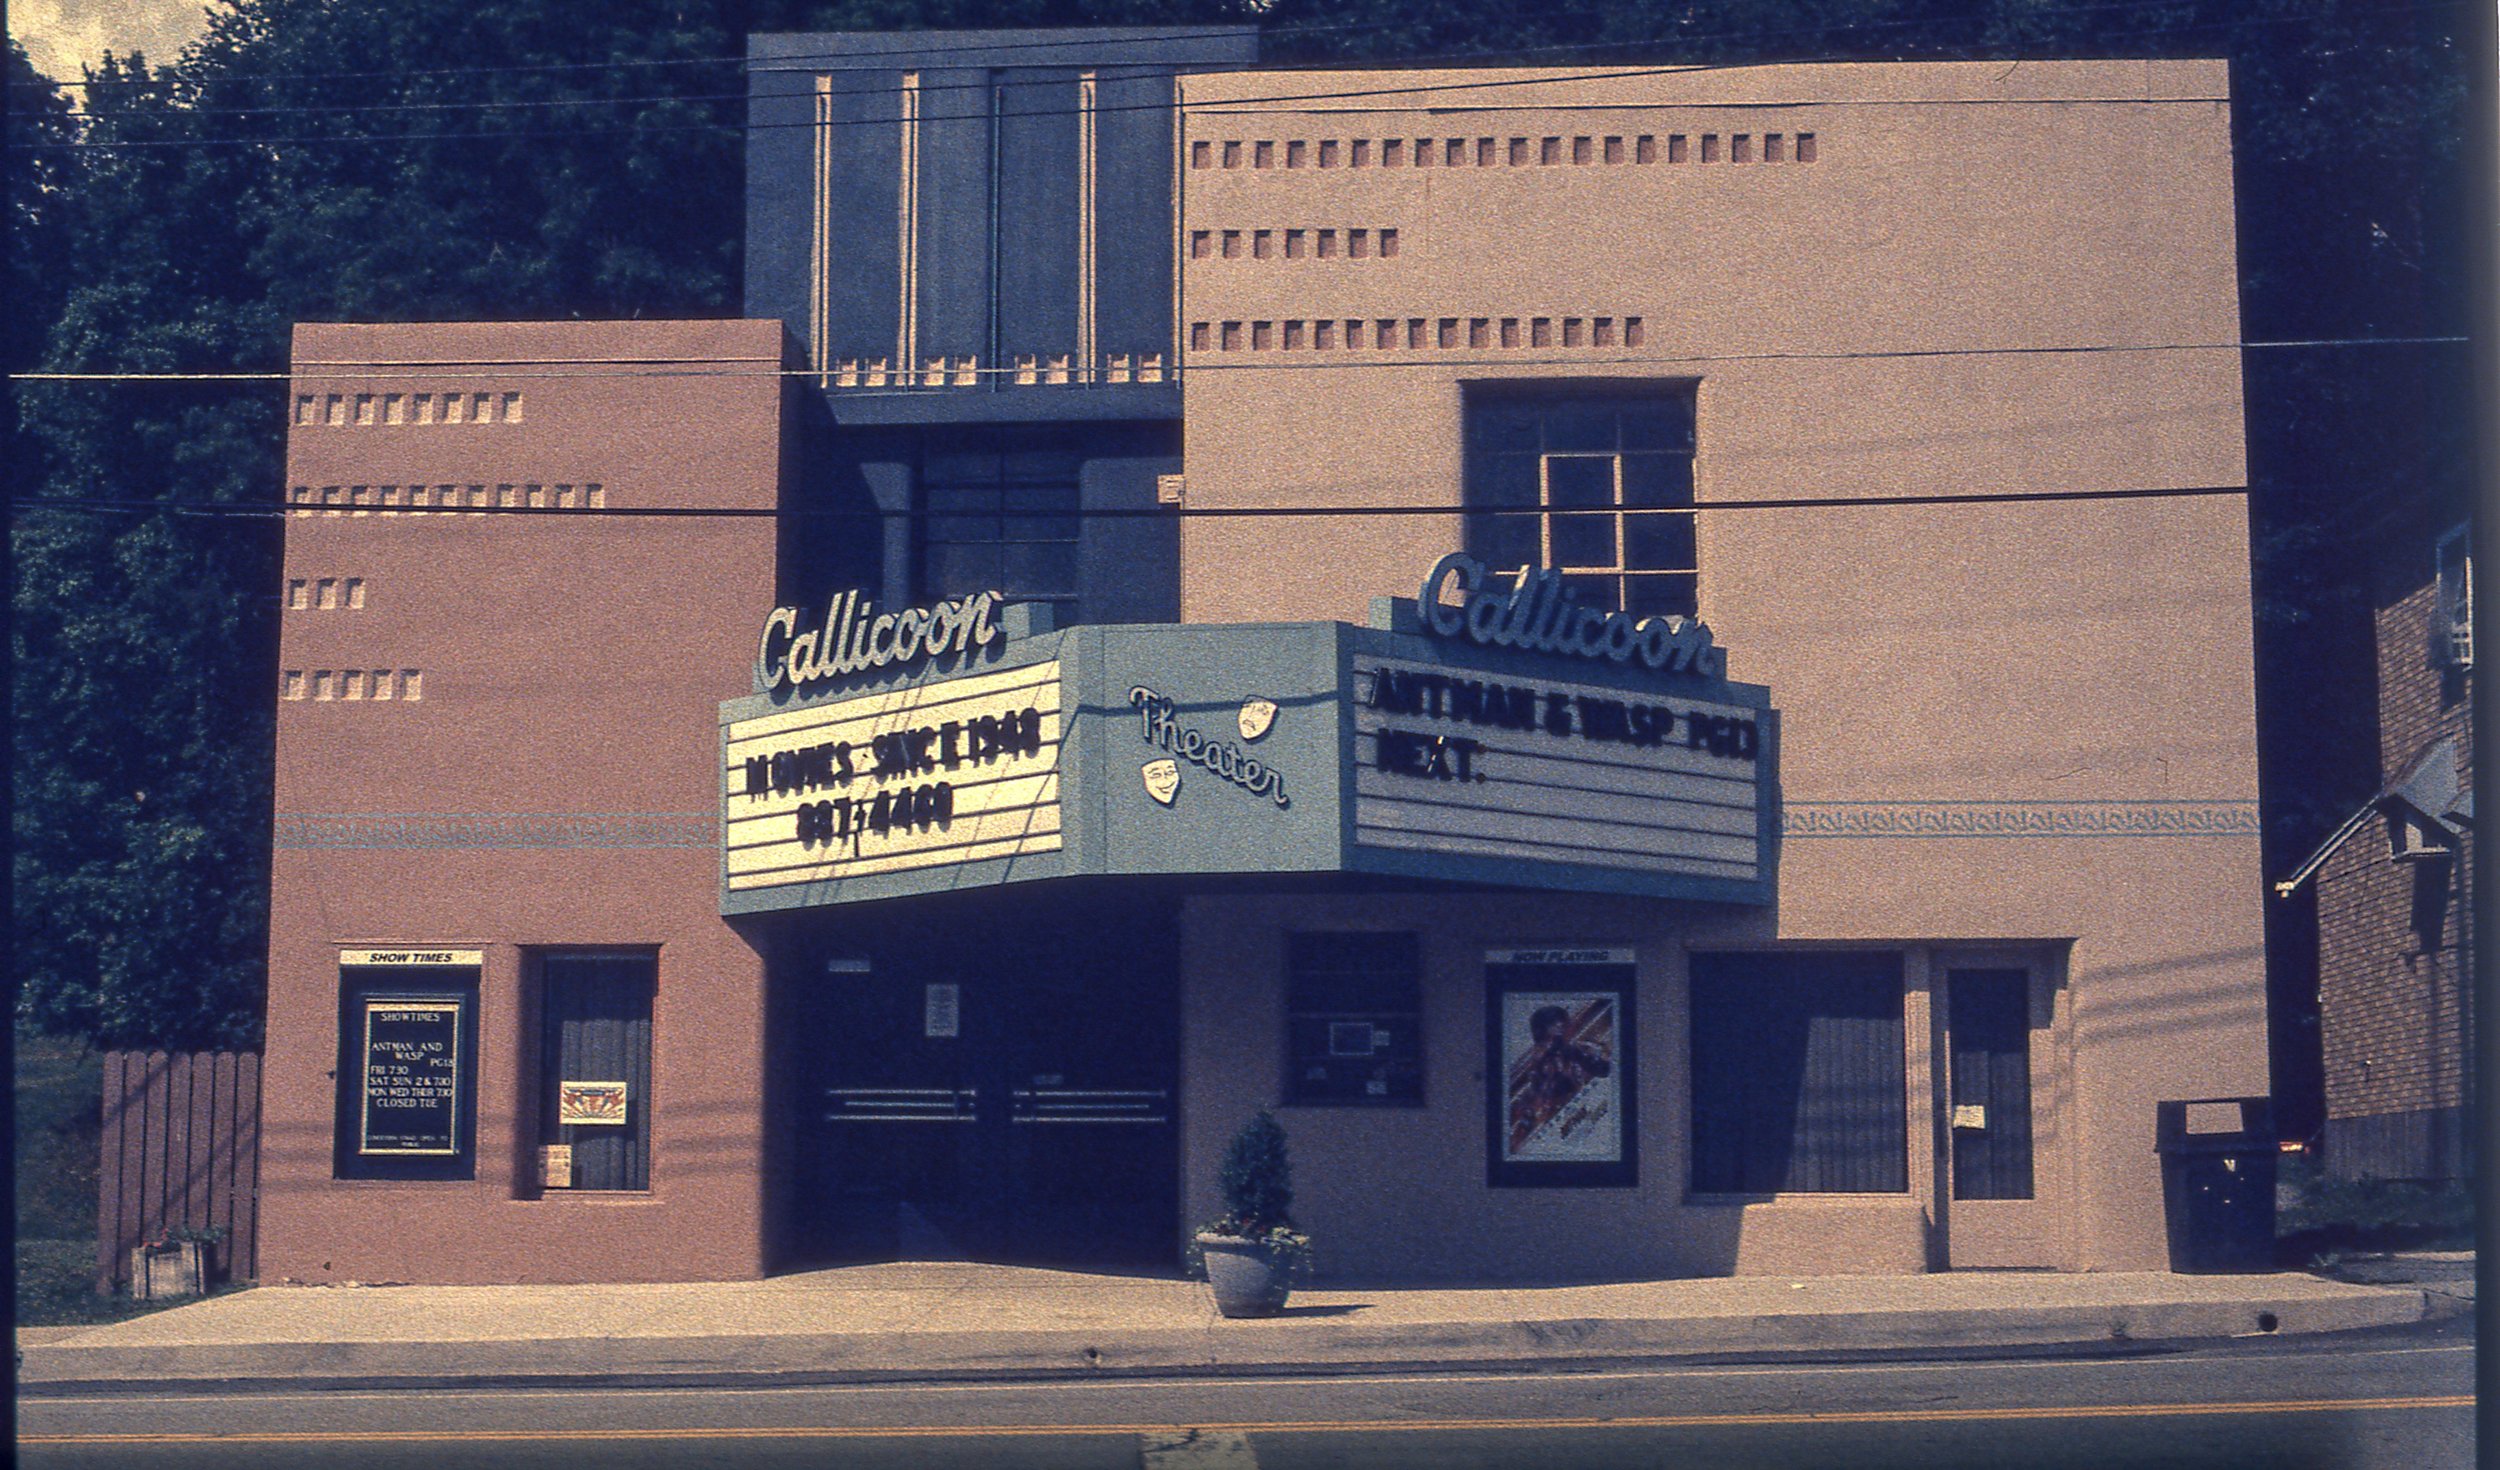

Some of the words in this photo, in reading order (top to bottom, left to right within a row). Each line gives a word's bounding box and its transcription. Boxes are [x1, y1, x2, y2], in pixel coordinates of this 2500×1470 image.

[1418, 552, 1714, 675] Callicoon
[759, 589, 1003, 690] Callicoon
[1372, 667, 1536, 731] ANTMAN
[1544, 692, 1572, 738] &
[1577, 696, 1675, 748] WASP
[1129, 685, 1289, 805] Theater
[746, 741, 854, 797] MOVIES
[869, 720, 961, 778] SINCE
[369, 953, 410, 963] SHOW
[412, 952, 453, 963] TIMES
[380, 1012, 440, 1022] SHOWTIMES
[371, 1041, 414, 1052] ANTMAN
[419, 1041, 444, 1052] AND
[394, 1051, 425, 1061] WASP
[430, 1058, 453, 1067] PG13
[370, 1065, 386, 1075] FRI
[369, 1076, 389, 1086] SAT
[392, 1076, 413, 1086] SUN
[415, 1076, 423, 1086] 2
[424, 1076, 432, 1086] &
[368, 1087, 387, 1097] MON
[389, 1087, 410, 1097] WED
[376, 1098, 417, 1108] CLOSED
[420, 1098, 438, 1108] TUE
